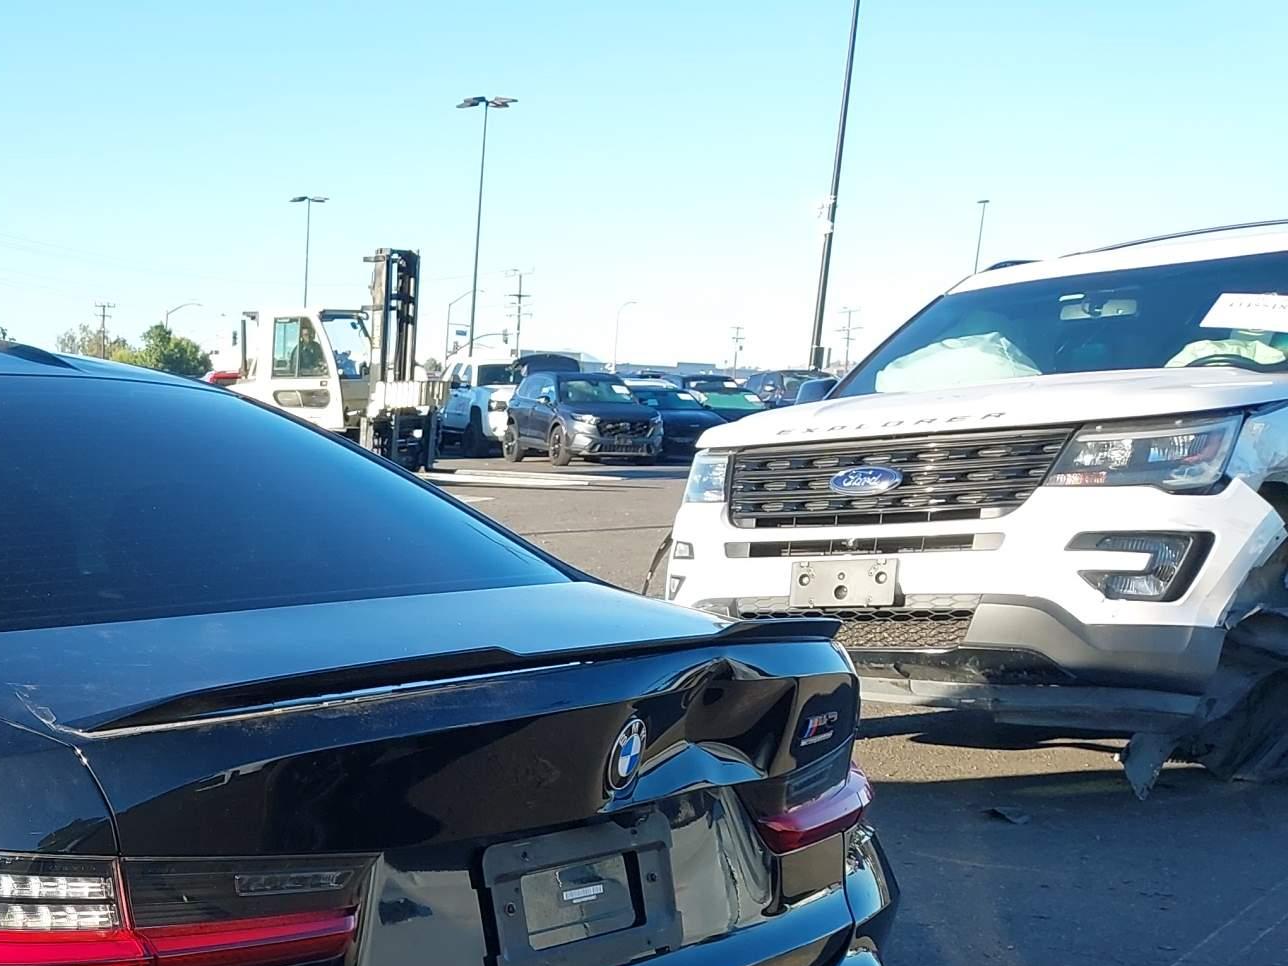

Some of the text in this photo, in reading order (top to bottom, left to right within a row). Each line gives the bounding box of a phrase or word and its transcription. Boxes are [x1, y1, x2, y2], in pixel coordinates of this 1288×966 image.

[776, 412, 1006, 435] EXPLORER
[842, 470, 882, 487] Ford
[618, 721, 646, 748] BMW
